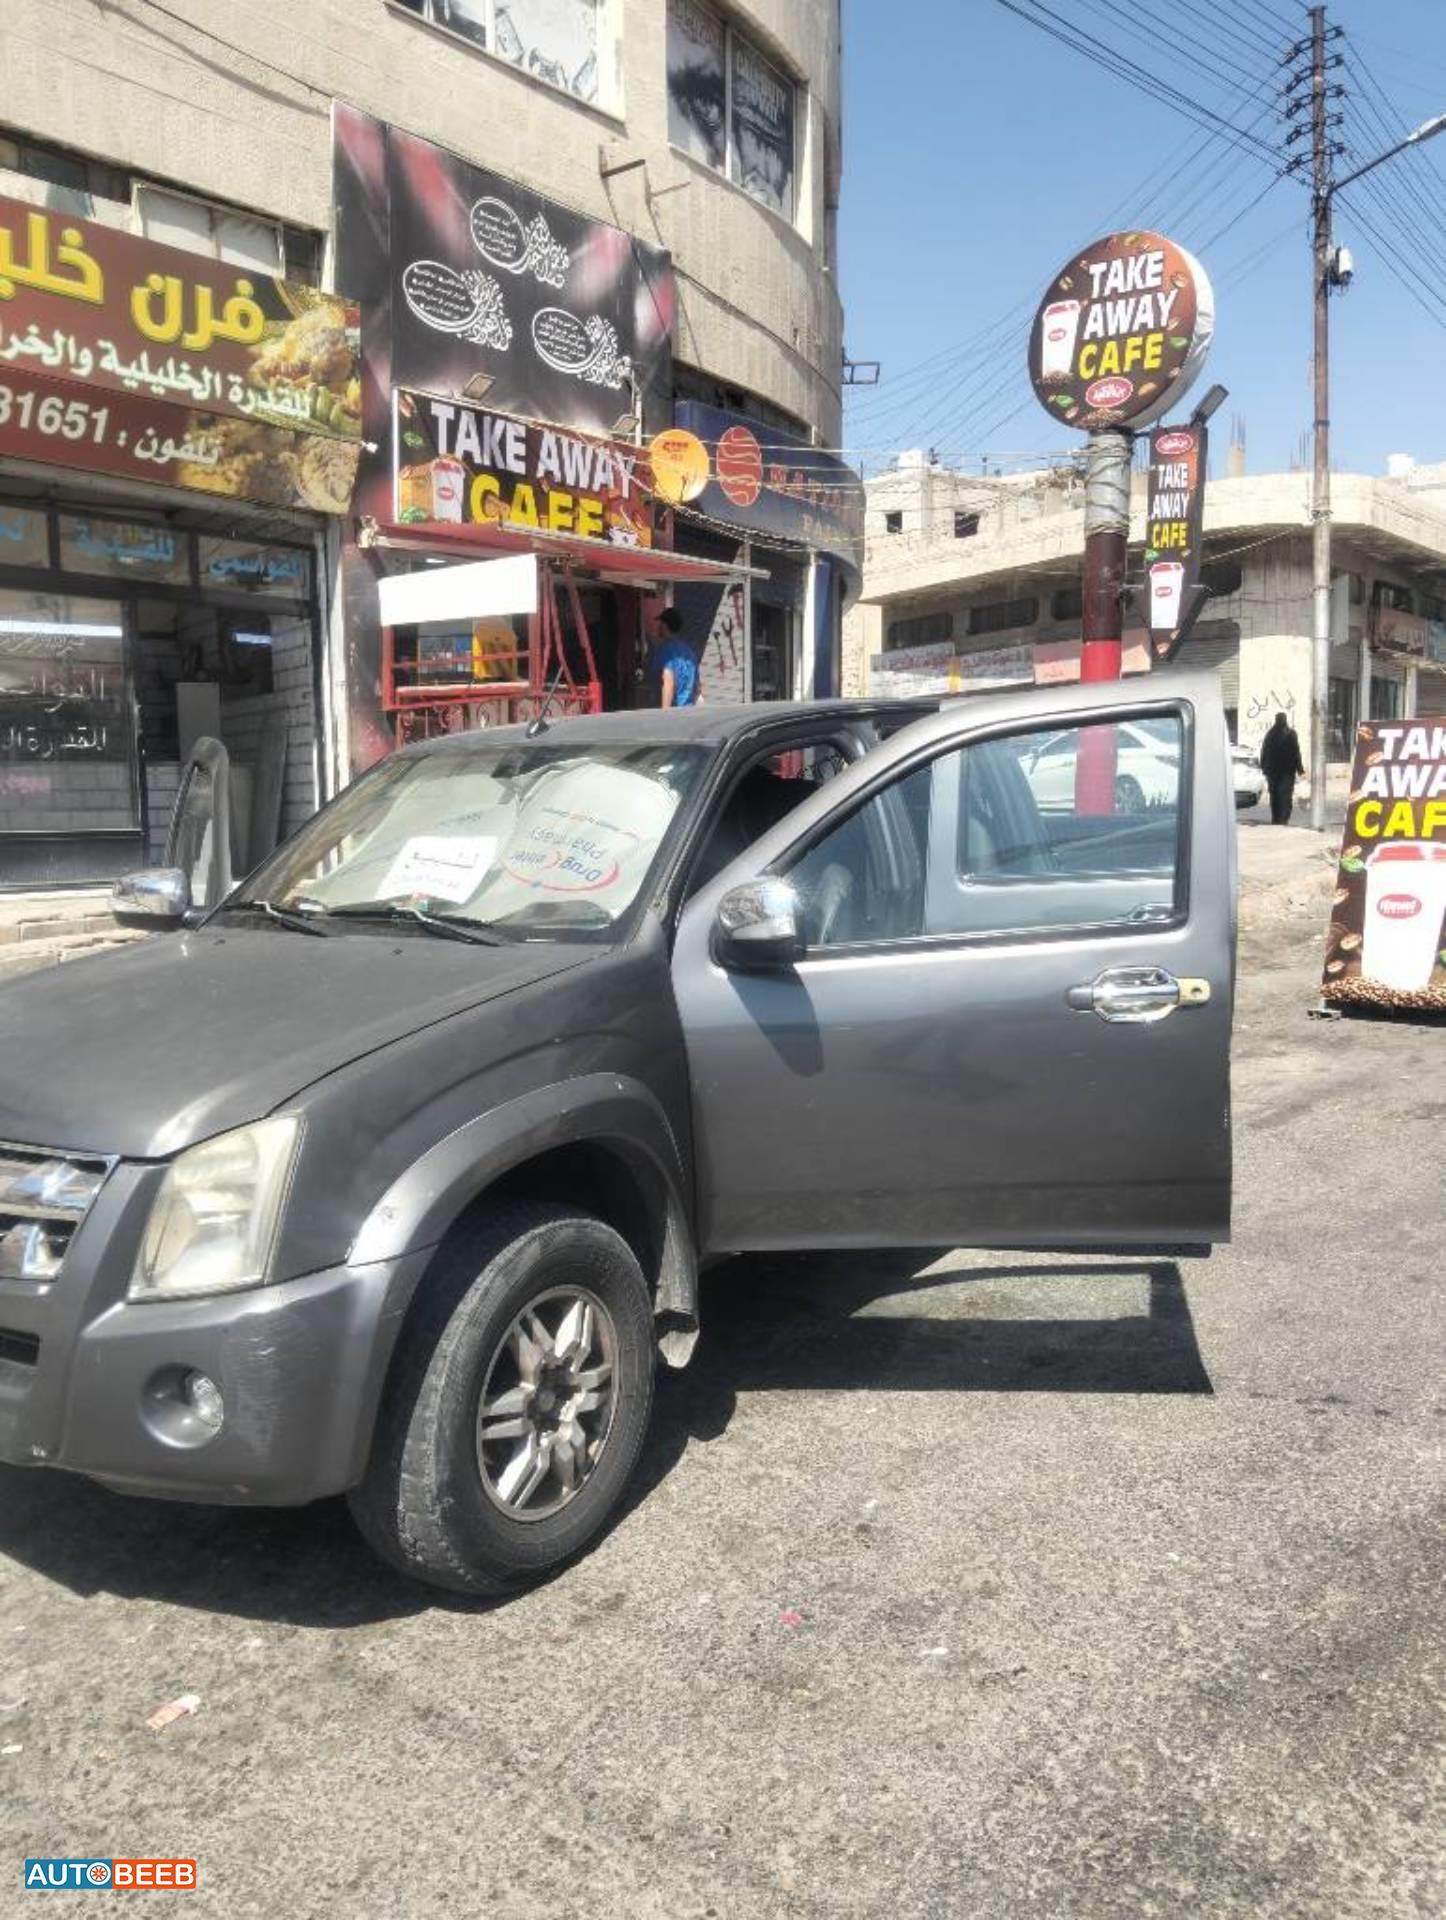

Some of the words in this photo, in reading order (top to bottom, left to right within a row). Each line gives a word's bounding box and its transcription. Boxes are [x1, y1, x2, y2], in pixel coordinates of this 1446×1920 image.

[1088, 250, 1164, 299] TAKE
[131, 273, 264, 350] فرن
[1082, 288, 1179, 340] AWAY
[99, 339, 222, 400] الخليلية
[1078, 333, 1164, 379] CAFE
[228, 374, 312, 419] للقدرة
[135, 427, 224, 465] تلفون
[431, 401, 527, 476] TAKE
[536, 428, 636, 499] AWAY
[1157, 462, 1189, 491] TAKE
[470, 473, 604, 538] CAFE
[1150, 491, 1190, 520] AWAY
[1151, 521, 1188, 549] CAFE
